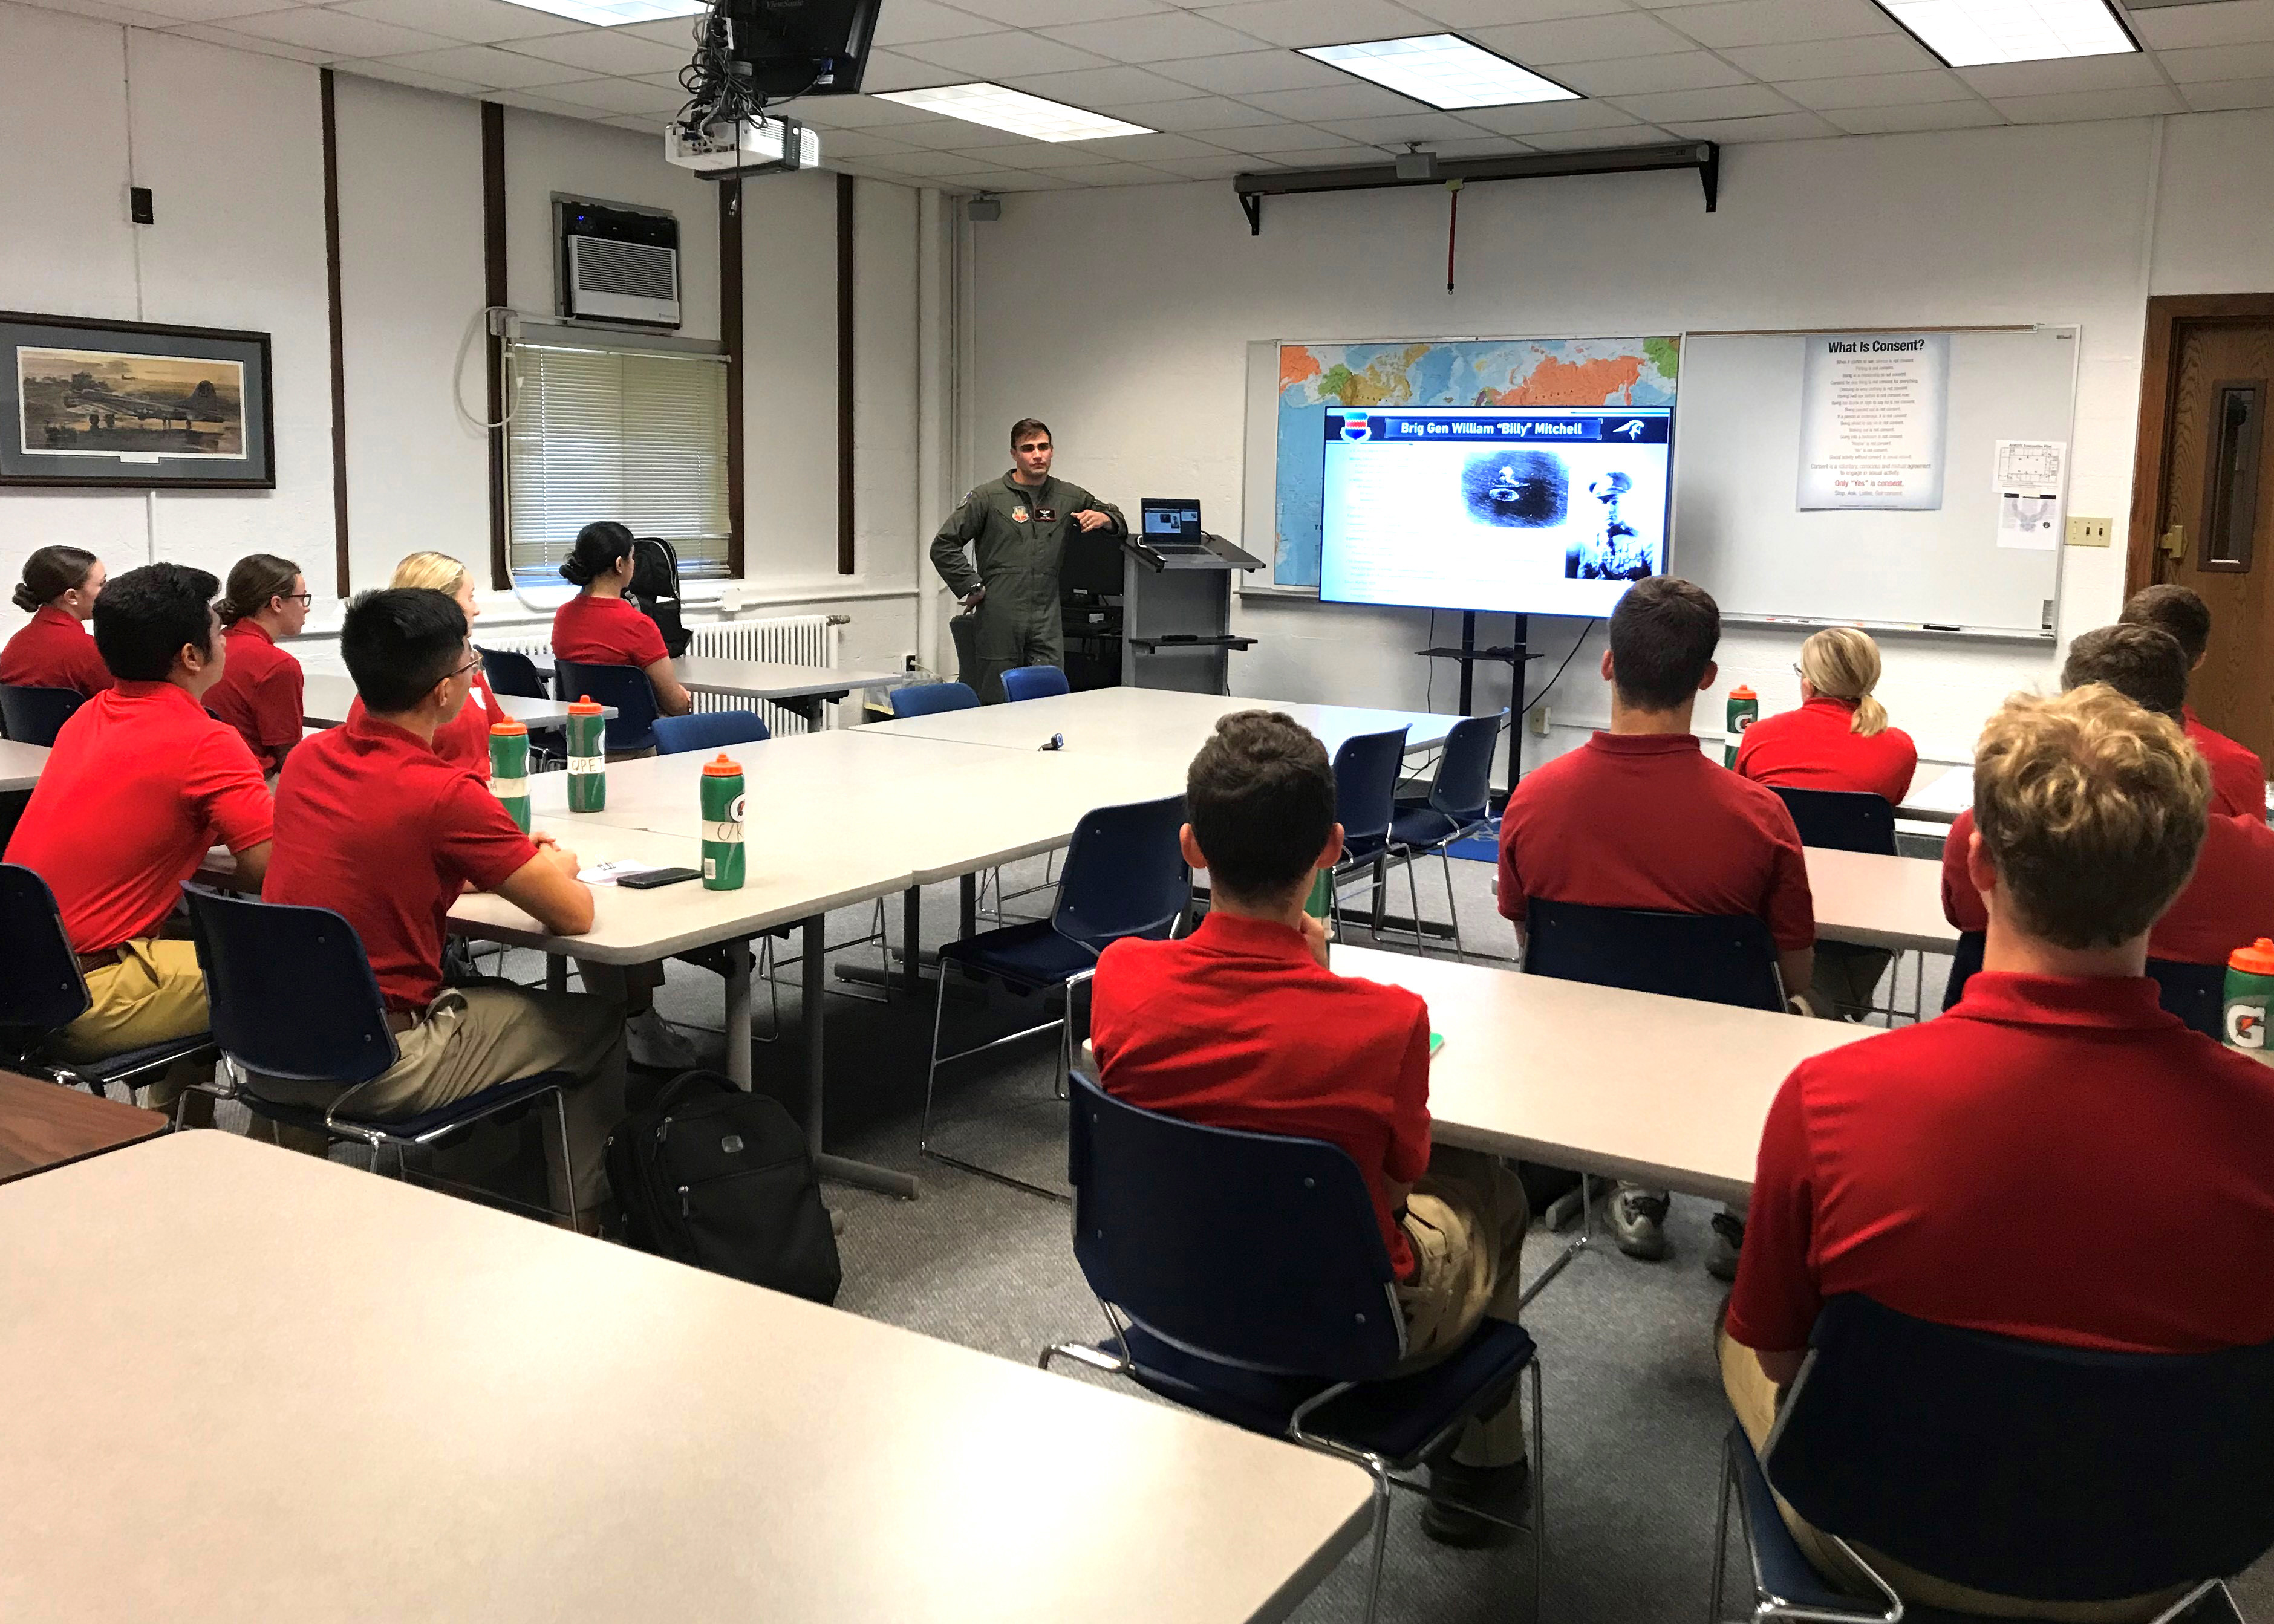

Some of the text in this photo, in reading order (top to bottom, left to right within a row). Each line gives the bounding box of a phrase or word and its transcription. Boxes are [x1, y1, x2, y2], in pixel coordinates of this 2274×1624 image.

[1828, 339, 1925, 353] What Is Consent?
[1401, 422, 1424, 436] Brig
[1427, 422, 1449, 434] Gen
[1452, 421, 1494, 434] William
[1535, 423, 1582, 435] Mitchell
[1835, 479, 1849, 488] Only
[2227, 1004, 2266, 1048] G
